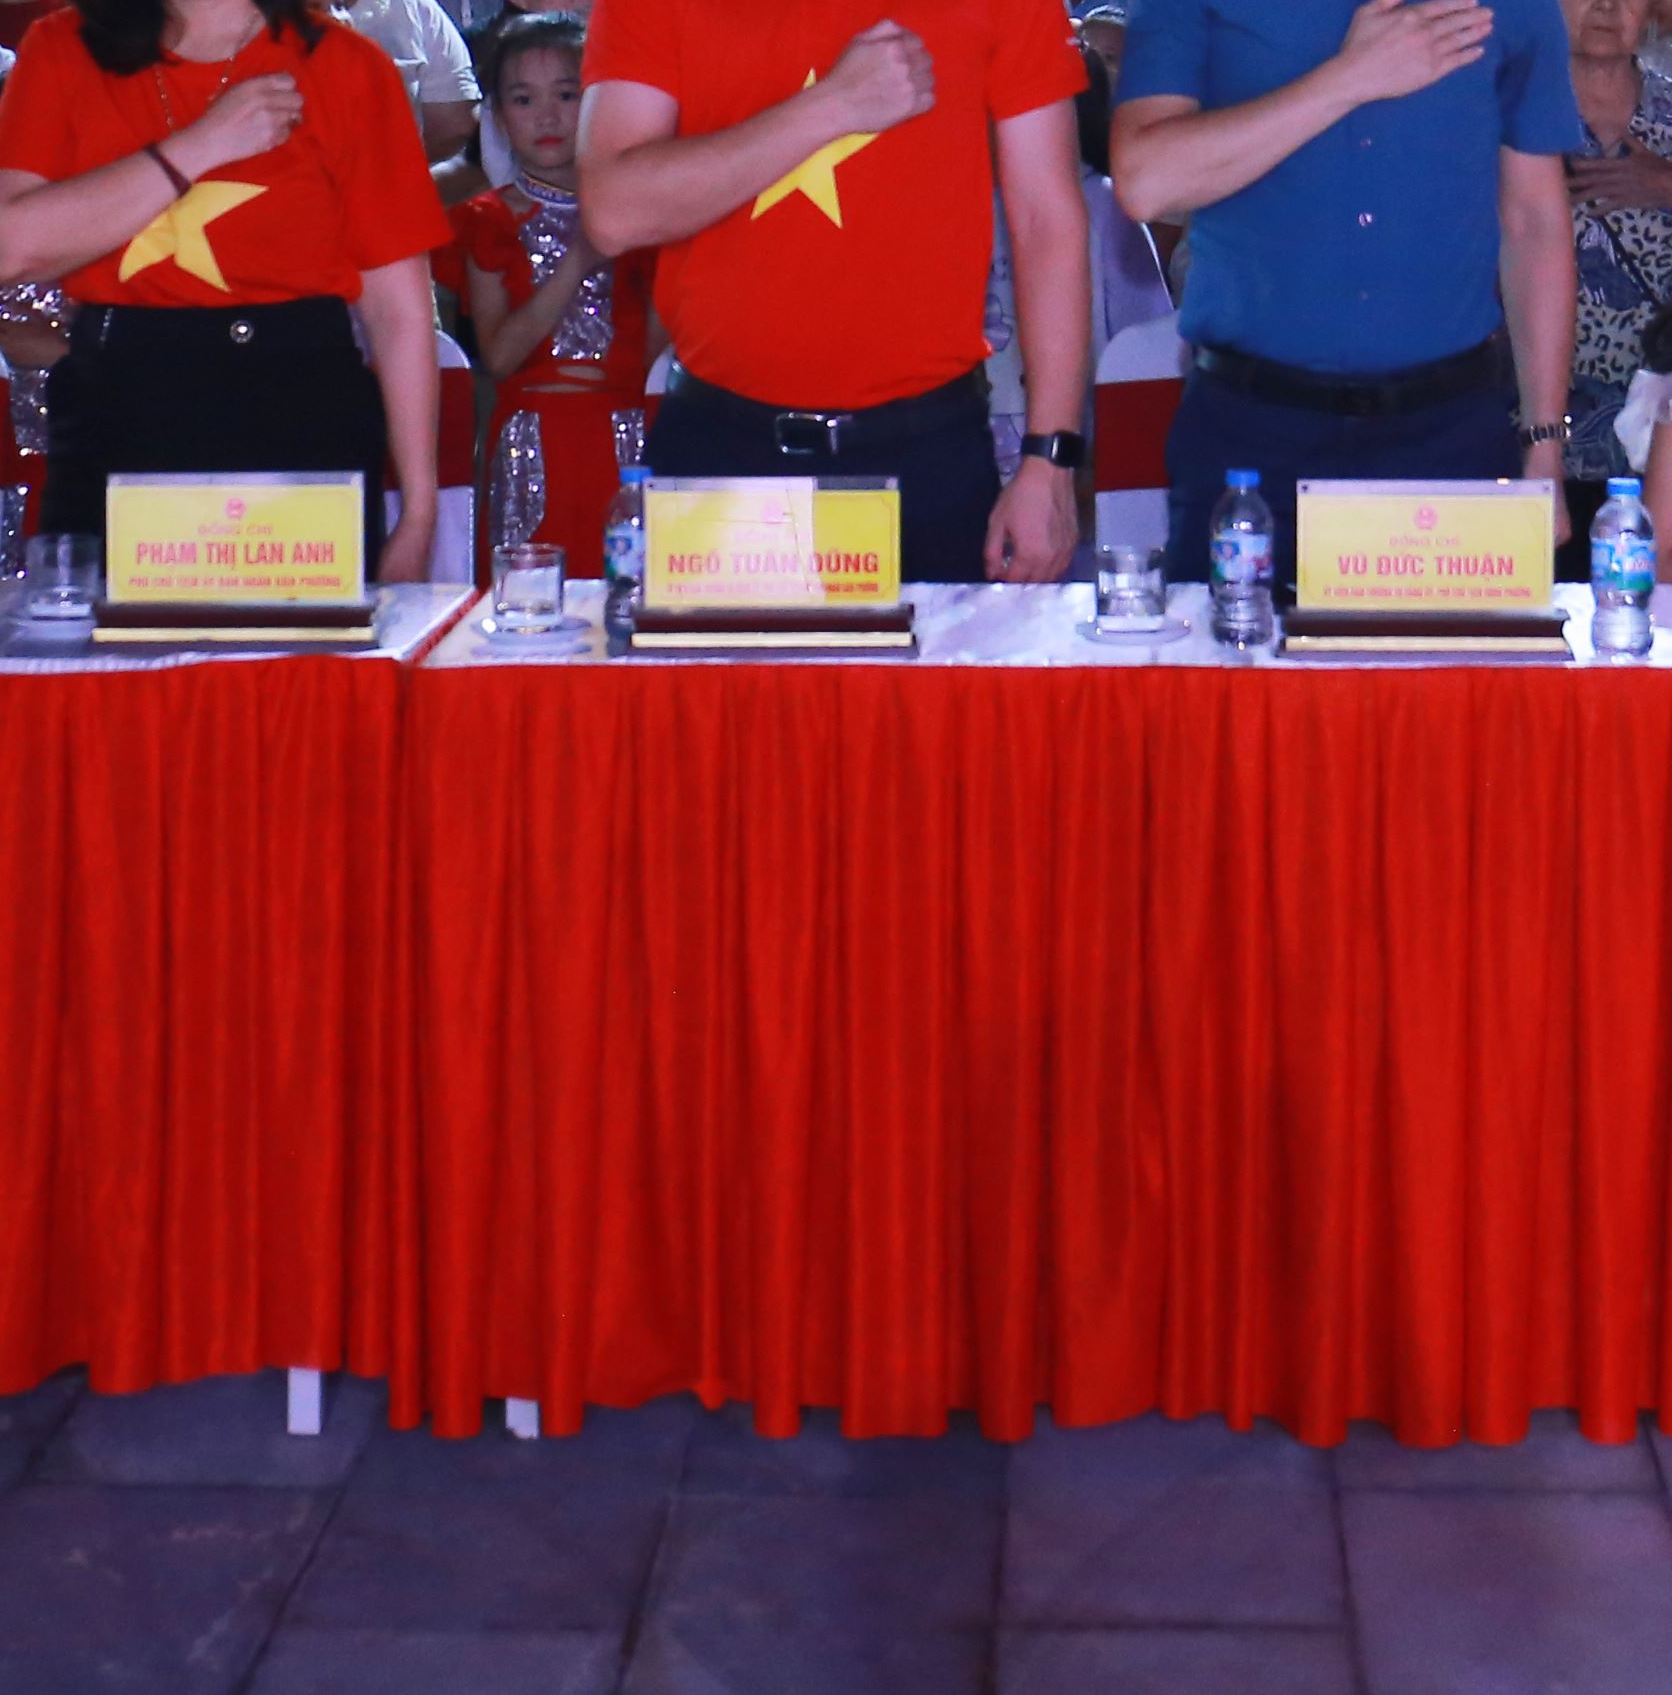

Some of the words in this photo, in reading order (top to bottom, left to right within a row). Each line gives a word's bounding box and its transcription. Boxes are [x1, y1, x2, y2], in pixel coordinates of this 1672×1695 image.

[206, 542, 236, 570] THỊ
[244, 542, 284, 565] LAN
[292, 542, 335, 565] ANH
[668, 548, 721, 574] NGÔ
[1435, 551, 1515, 582] THUẬN
